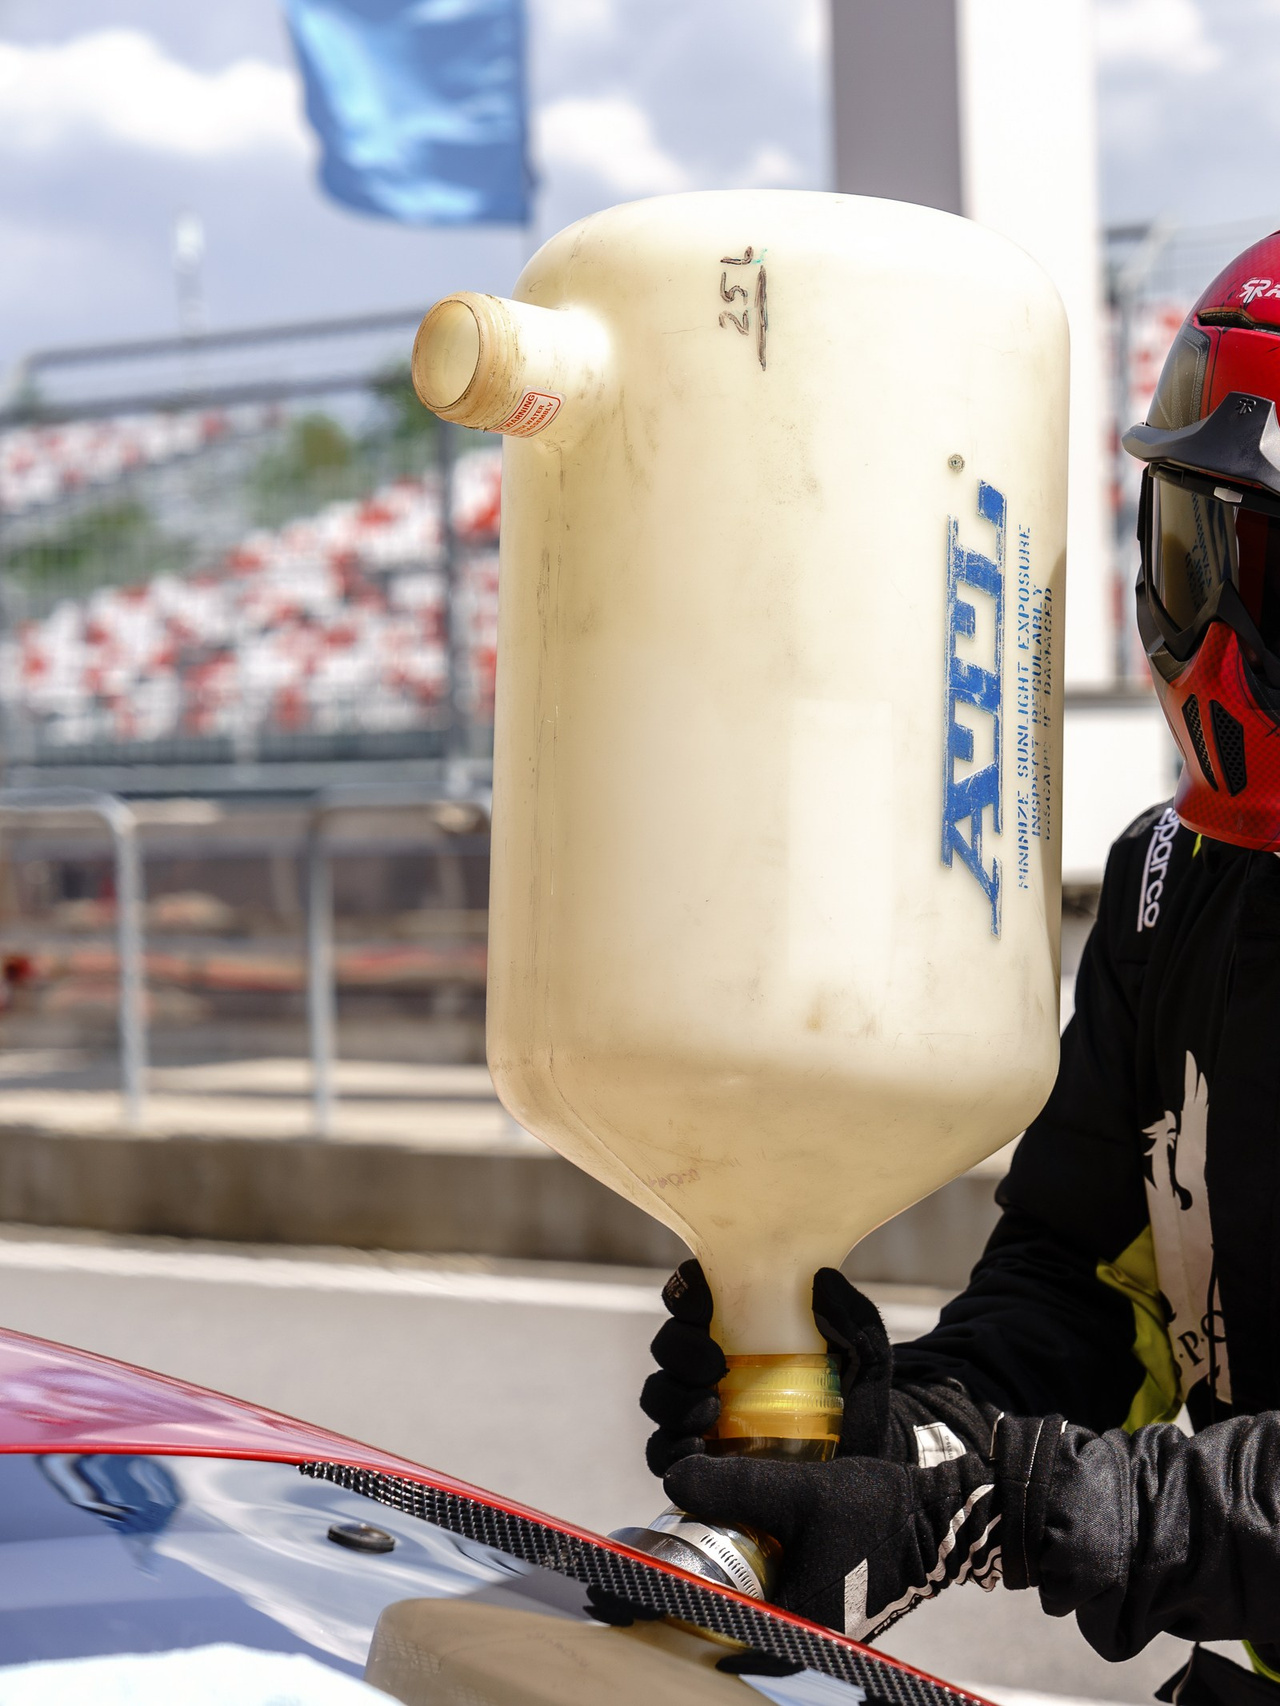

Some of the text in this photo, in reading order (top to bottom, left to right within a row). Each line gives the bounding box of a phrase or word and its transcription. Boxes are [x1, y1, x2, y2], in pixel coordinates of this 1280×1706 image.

[505, 395, 535, 428] WARNING
[1017, 524, 1031, 651] EXPOSURE
[1017, 662, 1029, 778] SUNLIGHT
